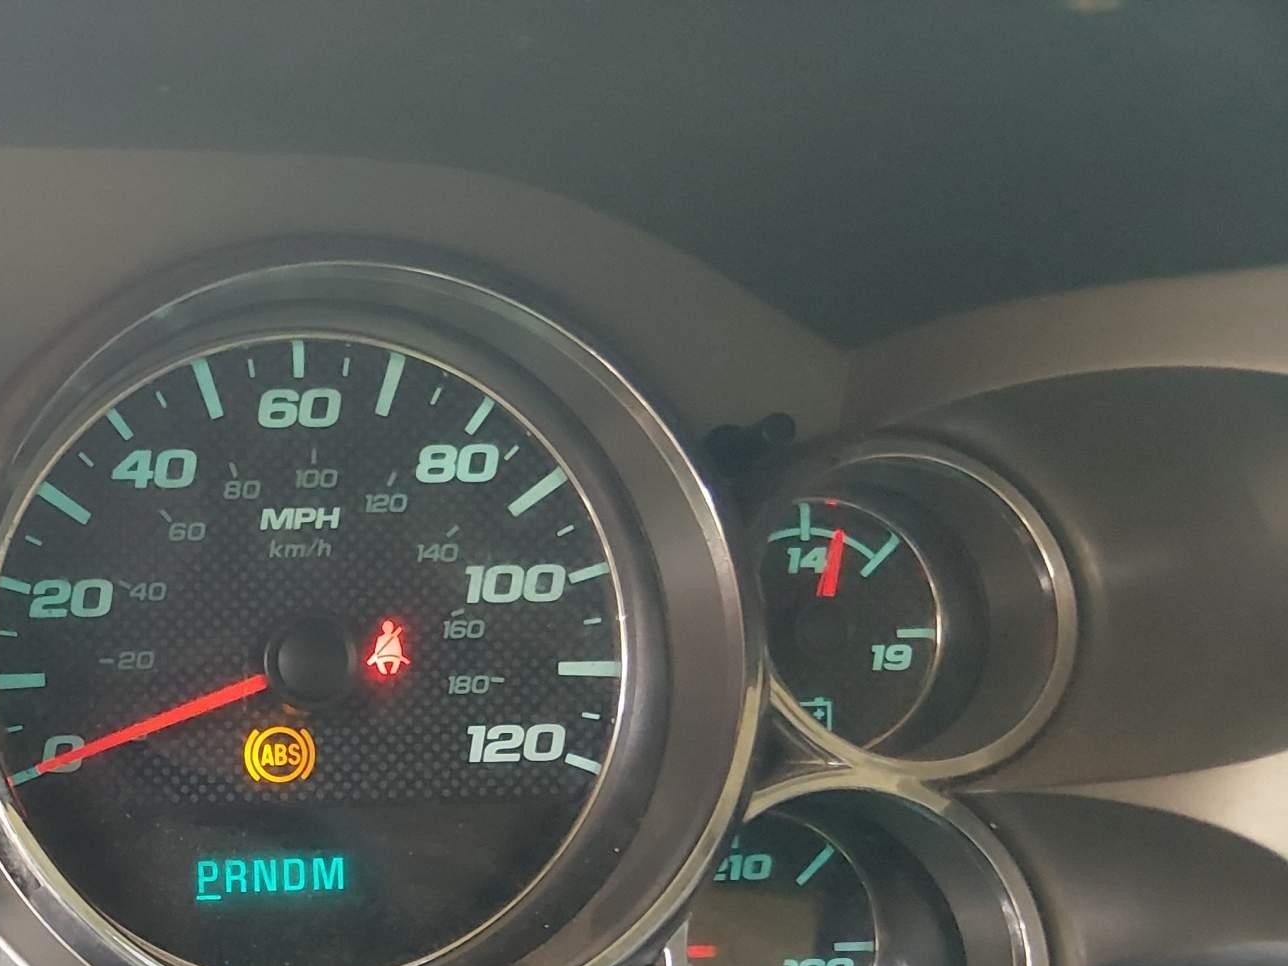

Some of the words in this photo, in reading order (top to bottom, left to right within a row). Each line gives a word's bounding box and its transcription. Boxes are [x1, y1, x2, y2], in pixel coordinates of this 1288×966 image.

[257, 388, 342, 428] 60
[111, 449, 197, 488] 40
[415, 444, 500, 484] 80
[223, 480, 261, 500] 80
[295, 469, 338, 489] 100
[365, 493, 408, 513] 120
[260, 507, 341, 530] MPH
[169, 521, 206, 542] 60
[269, 539, 332, 559] km/h
[416, 542, 459, 563] 140
[787, 547, 827, 574] 14
[128, 582, 167, 602] 40
[464, 563, 566, 604] 100
[27, 579, 113, 619] 20
[442, 618, 485, 640] 160
[116, 649, 155, 670] 20
[872, 644, 912, 671] 19
[447, 675, 490, 694] 180
[42, 734, 85, 773] 0
[260, 742, 302, 766] ABS
[466, 723, 566, 763] 120
[196, 855, 345, 893] PRNDM
